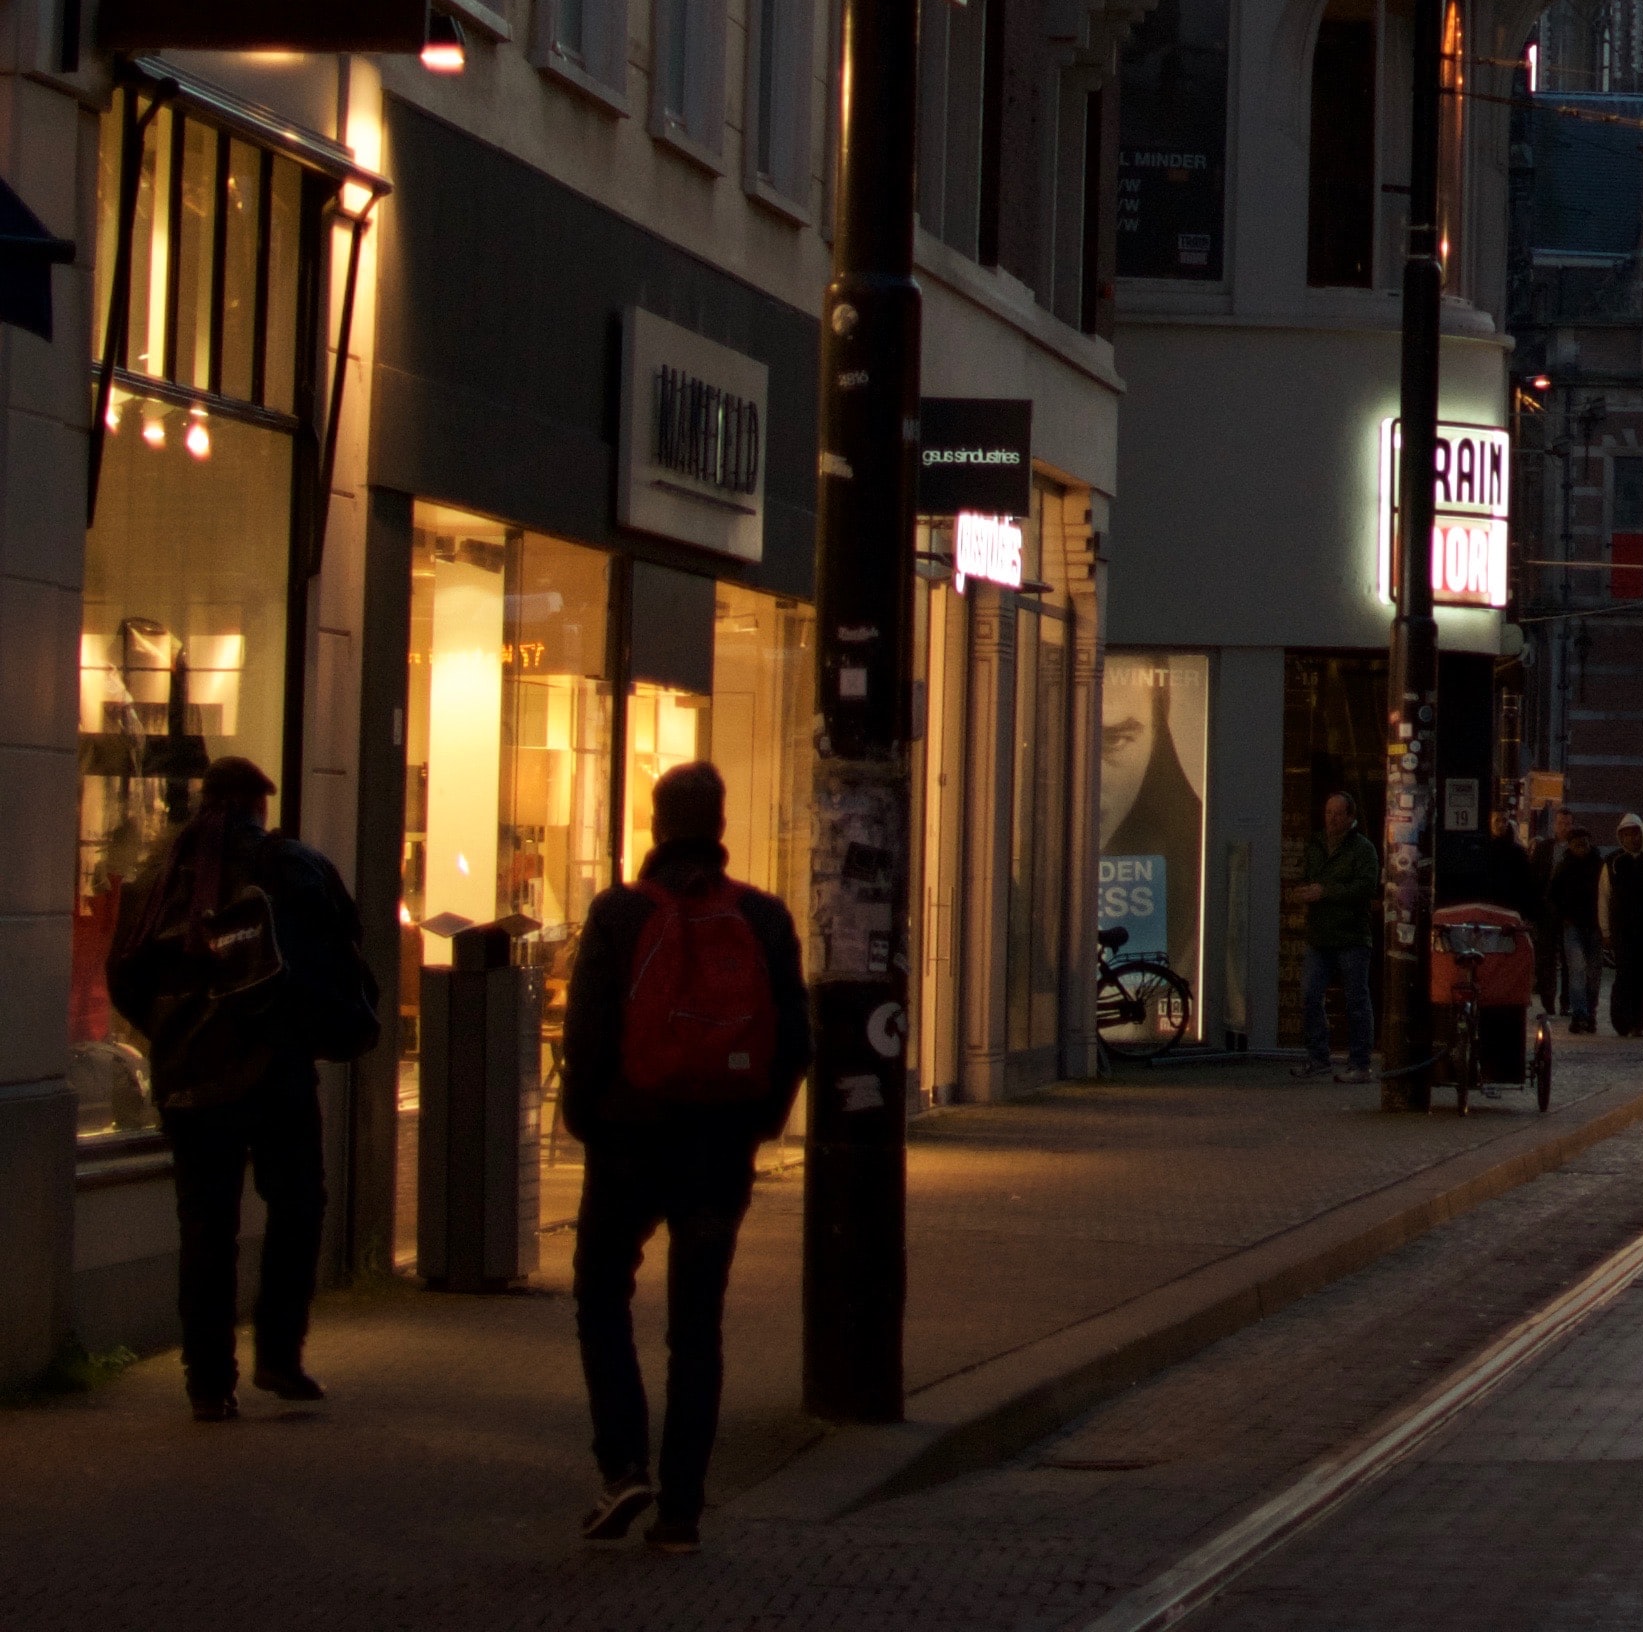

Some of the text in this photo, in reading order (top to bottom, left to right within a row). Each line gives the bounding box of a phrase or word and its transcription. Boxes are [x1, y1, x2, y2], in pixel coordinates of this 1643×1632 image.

[1134, 152, 1208, 169] MINDER
[1435, 437, 1503, 506] RAIN
[1453, 810, 1468, 826] 19
